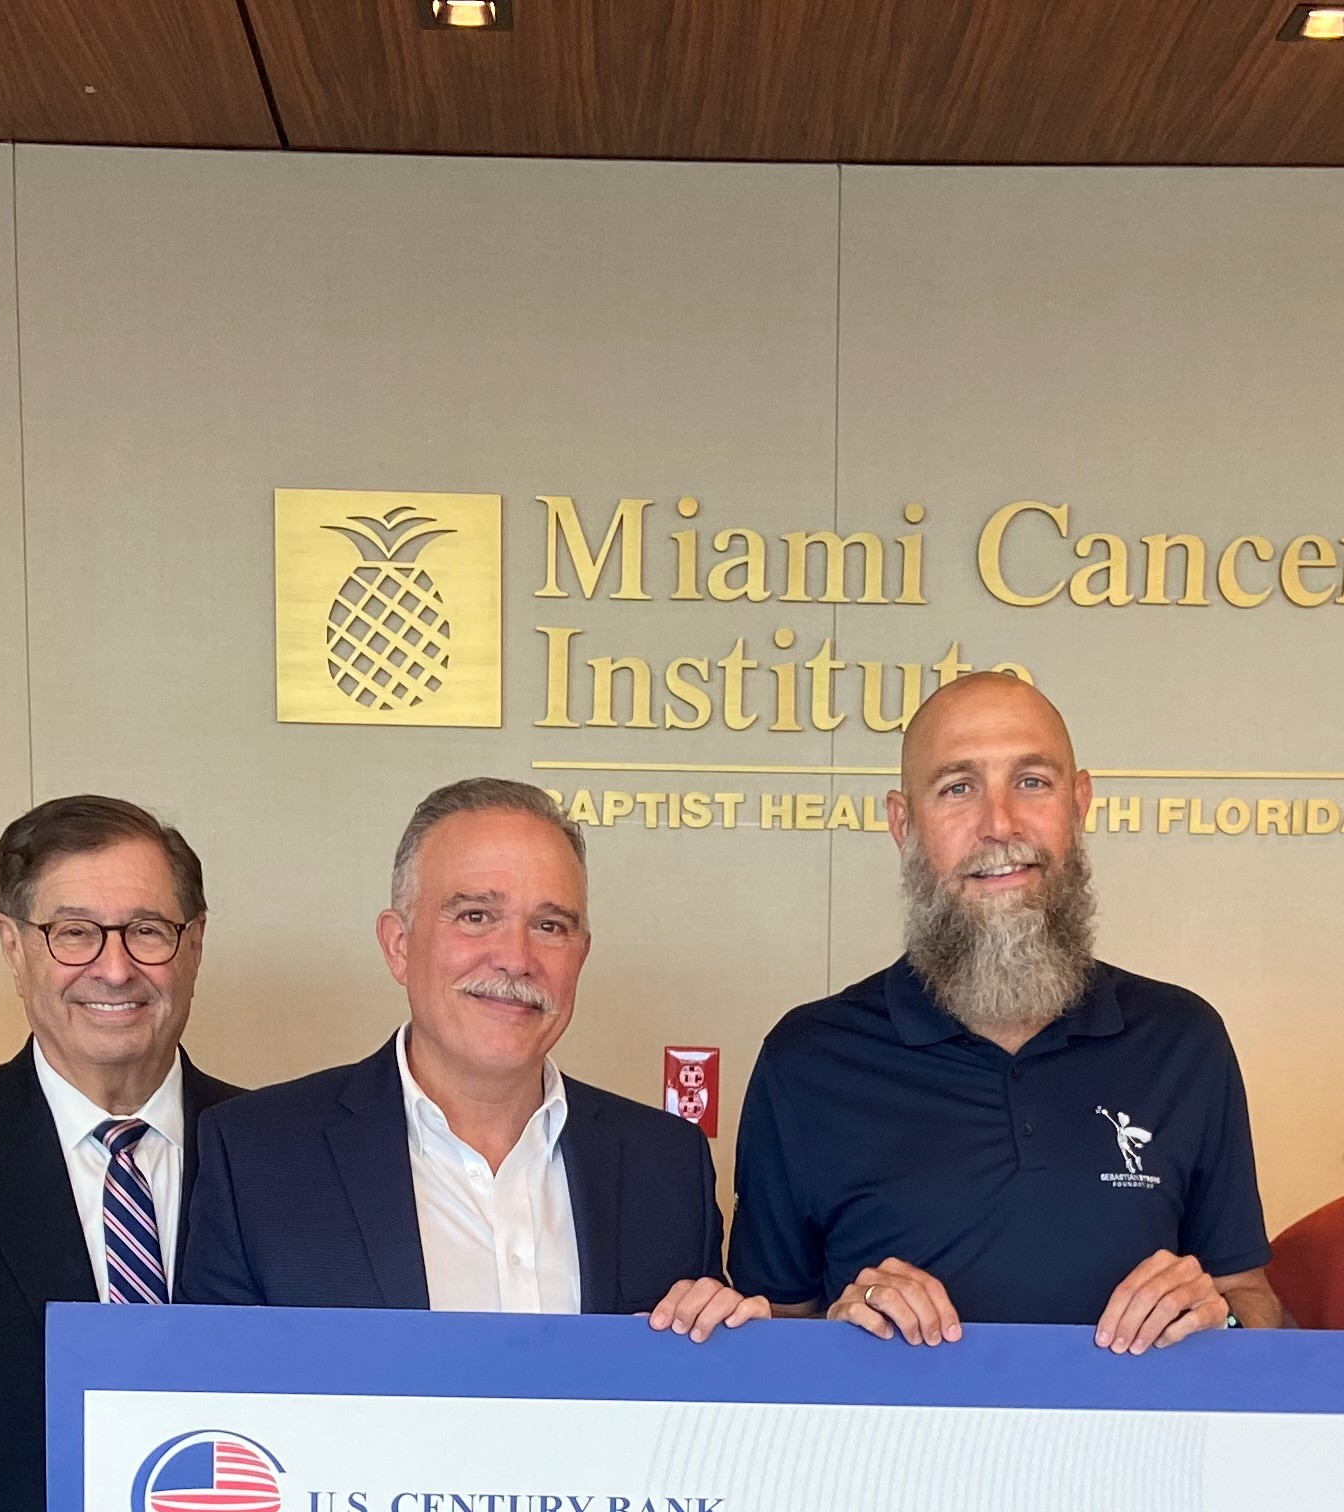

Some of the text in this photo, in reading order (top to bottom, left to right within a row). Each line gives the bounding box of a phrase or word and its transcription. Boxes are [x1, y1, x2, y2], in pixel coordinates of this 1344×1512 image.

[533, 494, 928, 607] Miami
[533, 626, 1034, 733] Institut
[760, 793, 891, 833] HEAL
